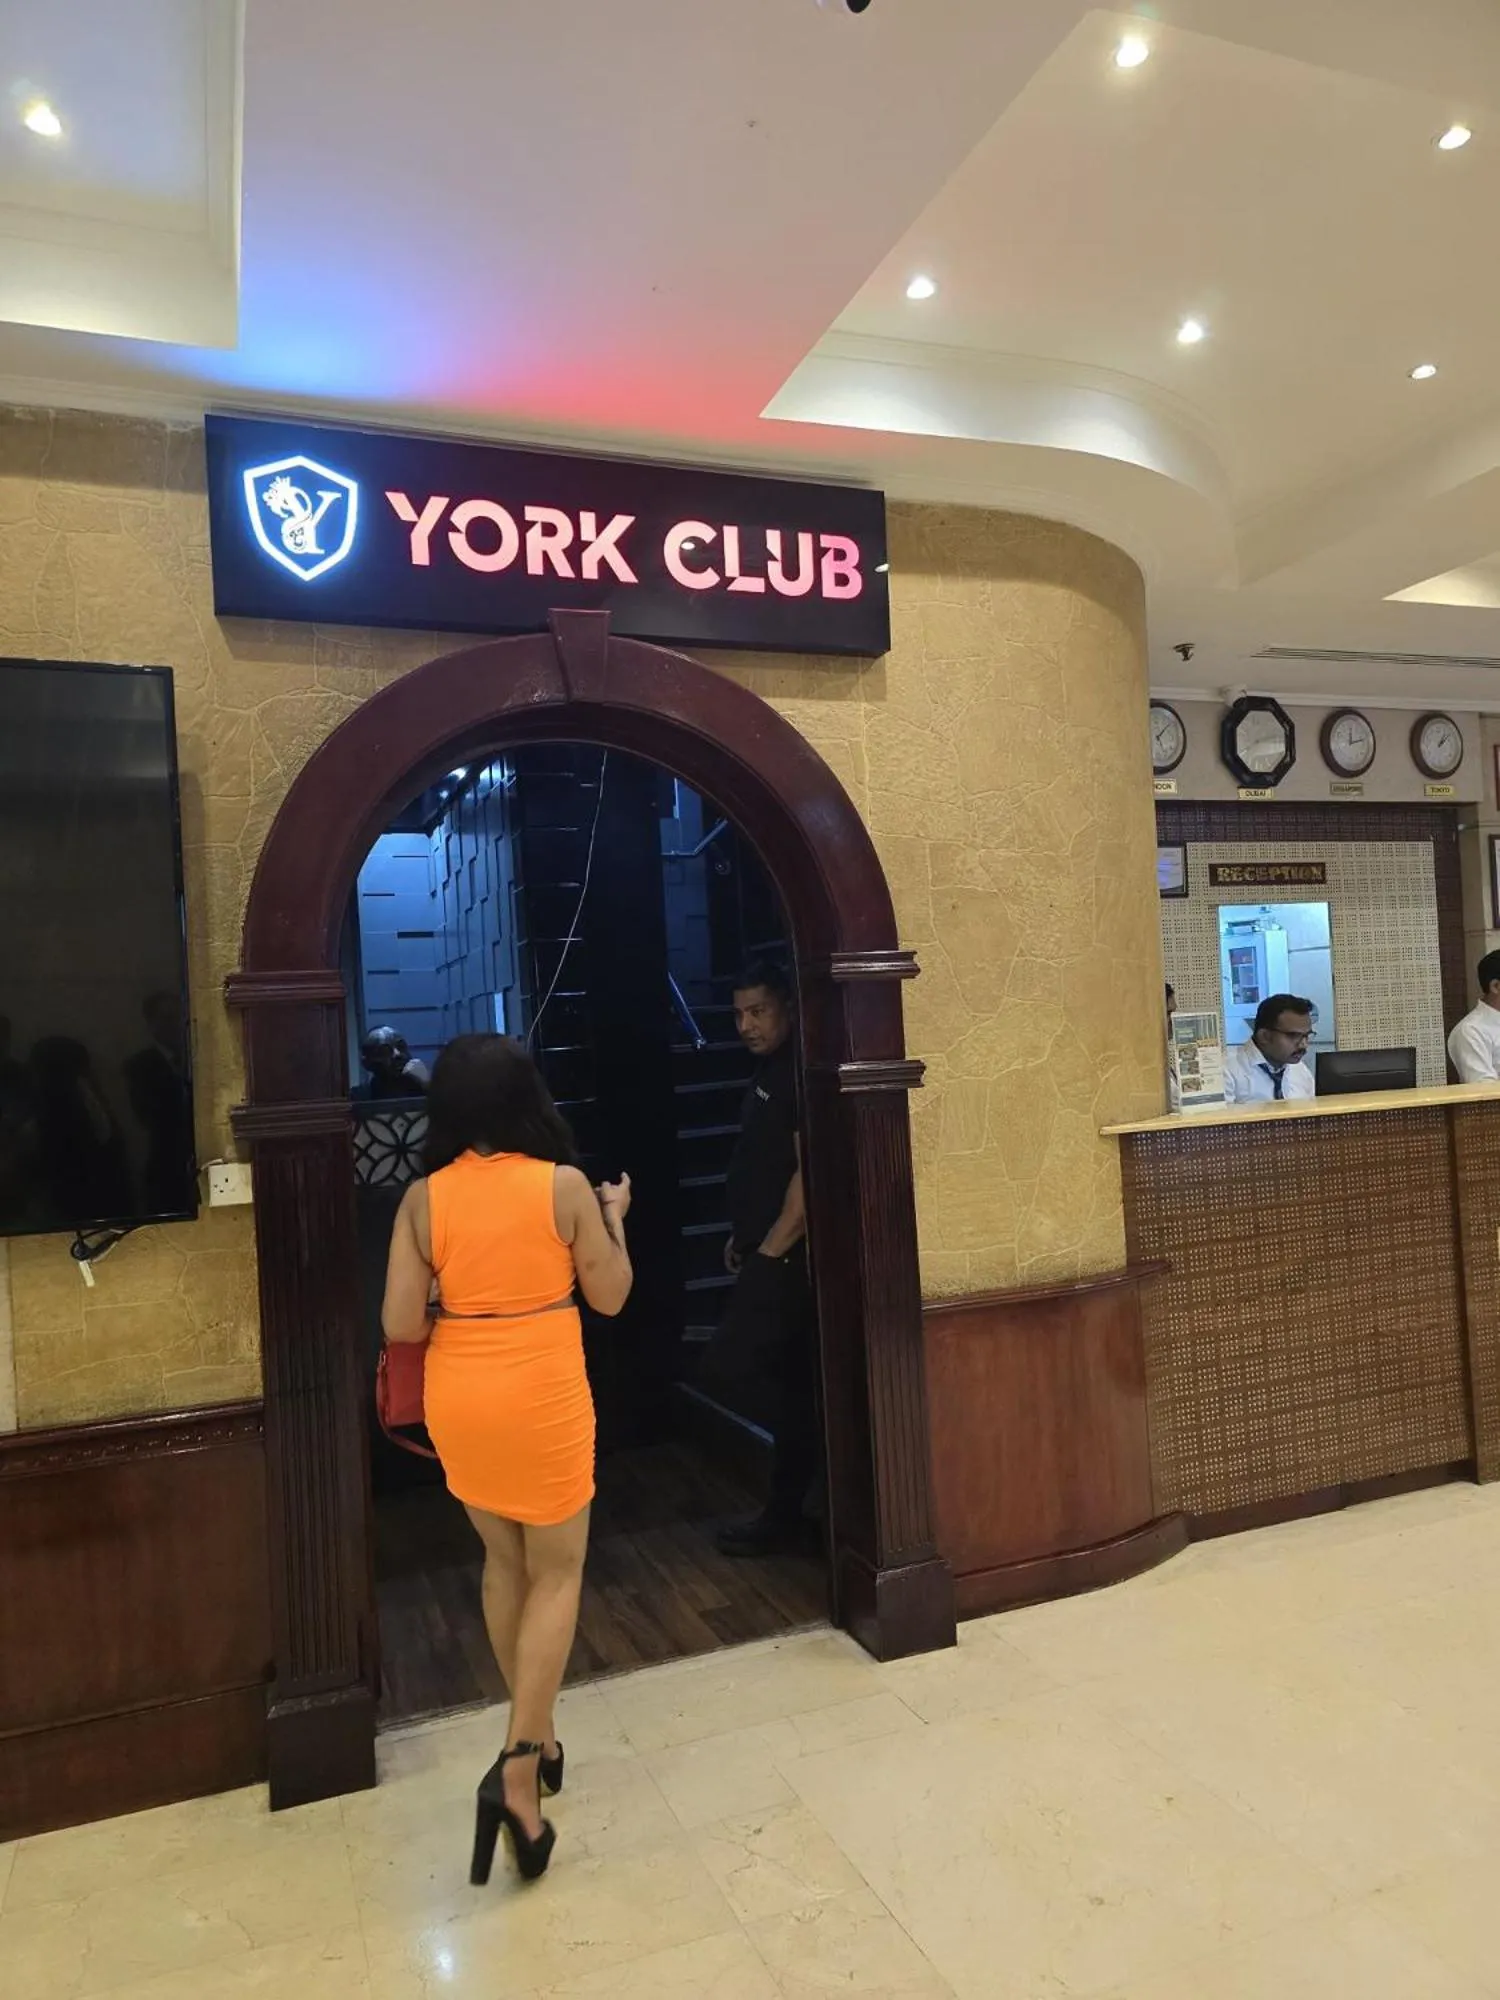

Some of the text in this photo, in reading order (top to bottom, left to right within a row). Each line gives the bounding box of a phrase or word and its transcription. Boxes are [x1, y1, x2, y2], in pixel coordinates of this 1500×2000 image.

[385, 491, 864, 600] YORK CLUB
[1216, 865, 1323, 882] RECEPTION
